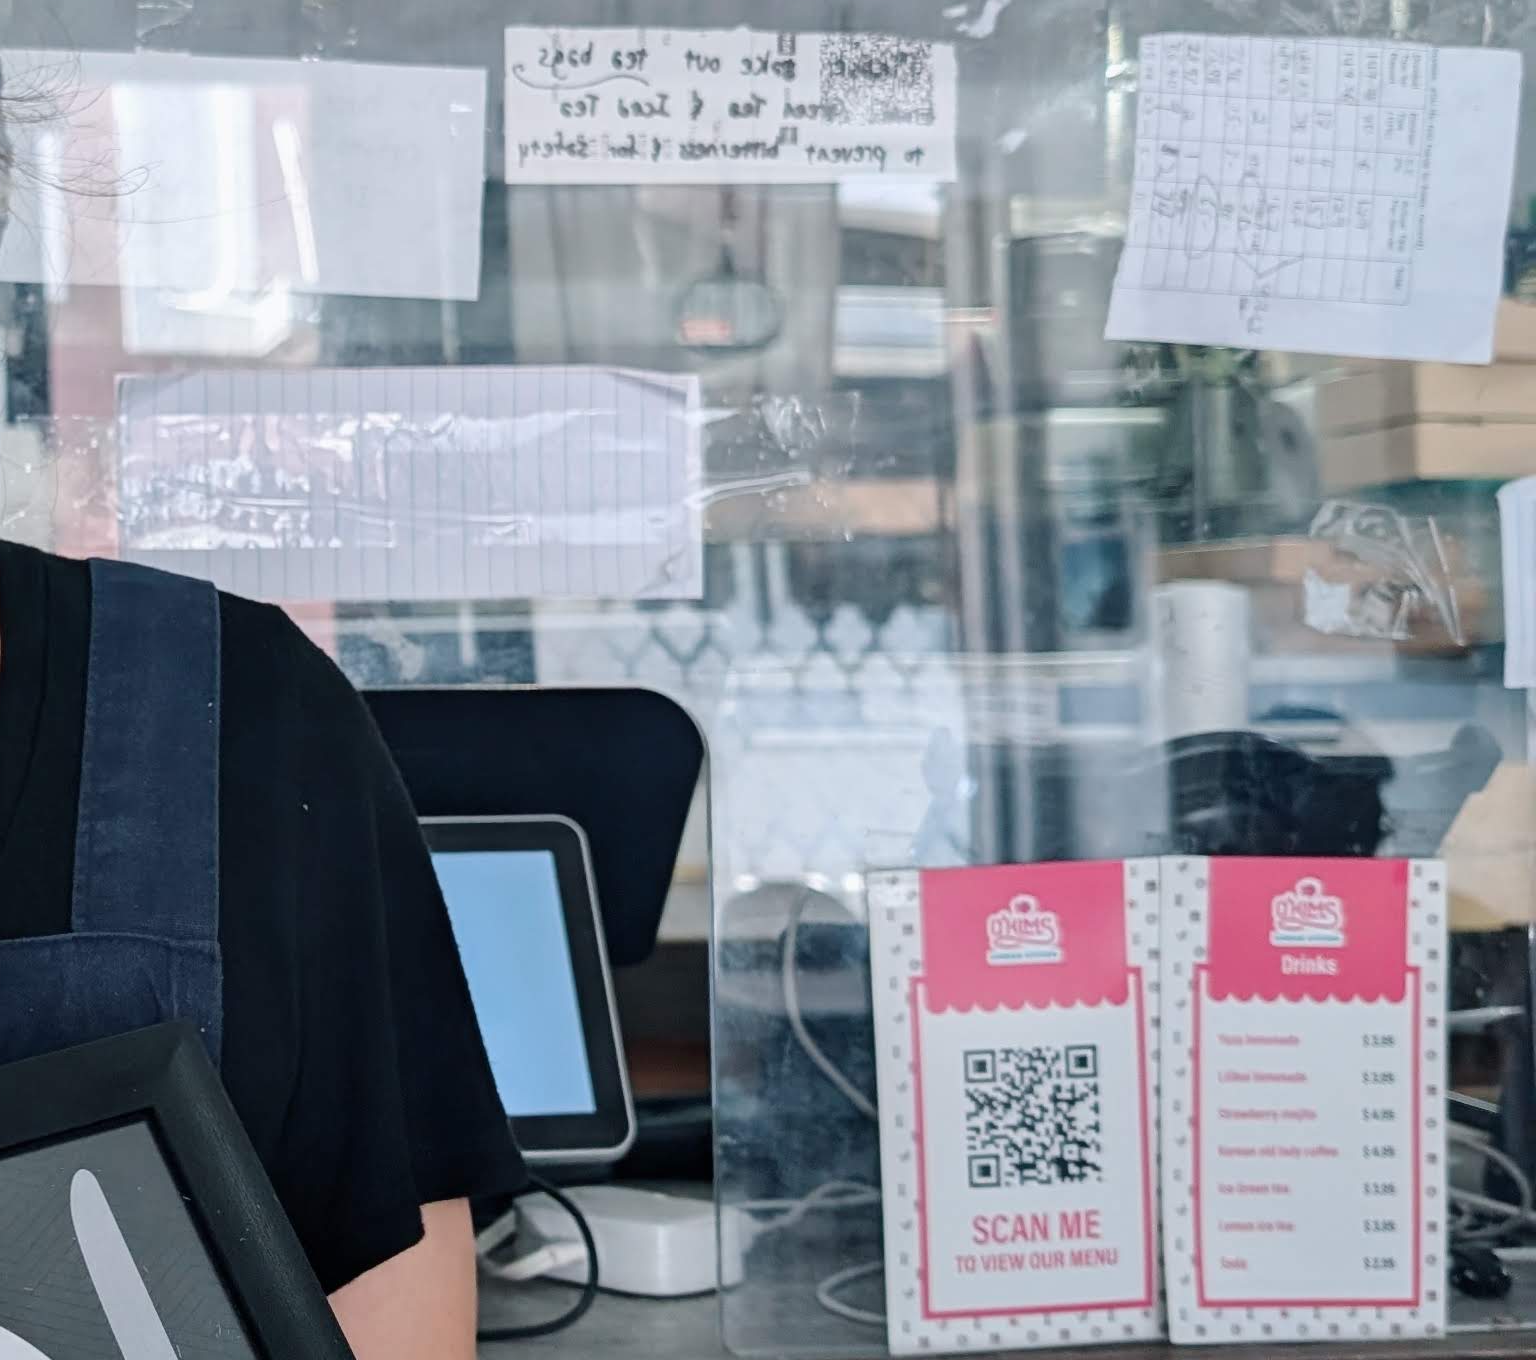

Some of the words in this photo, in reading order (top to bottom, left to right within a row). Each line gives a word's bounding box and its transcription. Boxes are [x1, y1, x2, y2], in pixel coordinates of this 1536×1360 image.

[1280, 954, 1339, 976] Drinks
[971, 1212, 1050, 1246] SCAN
[1058, 1207, 1102, 1241] ME
[954, 1253, 977, 1274] TO
[980, 1252, 1025, 1273] VIEW
[1029, 1250, 1066, 1270] OUR
[1069, 1247, 1120, 1268] MENU
